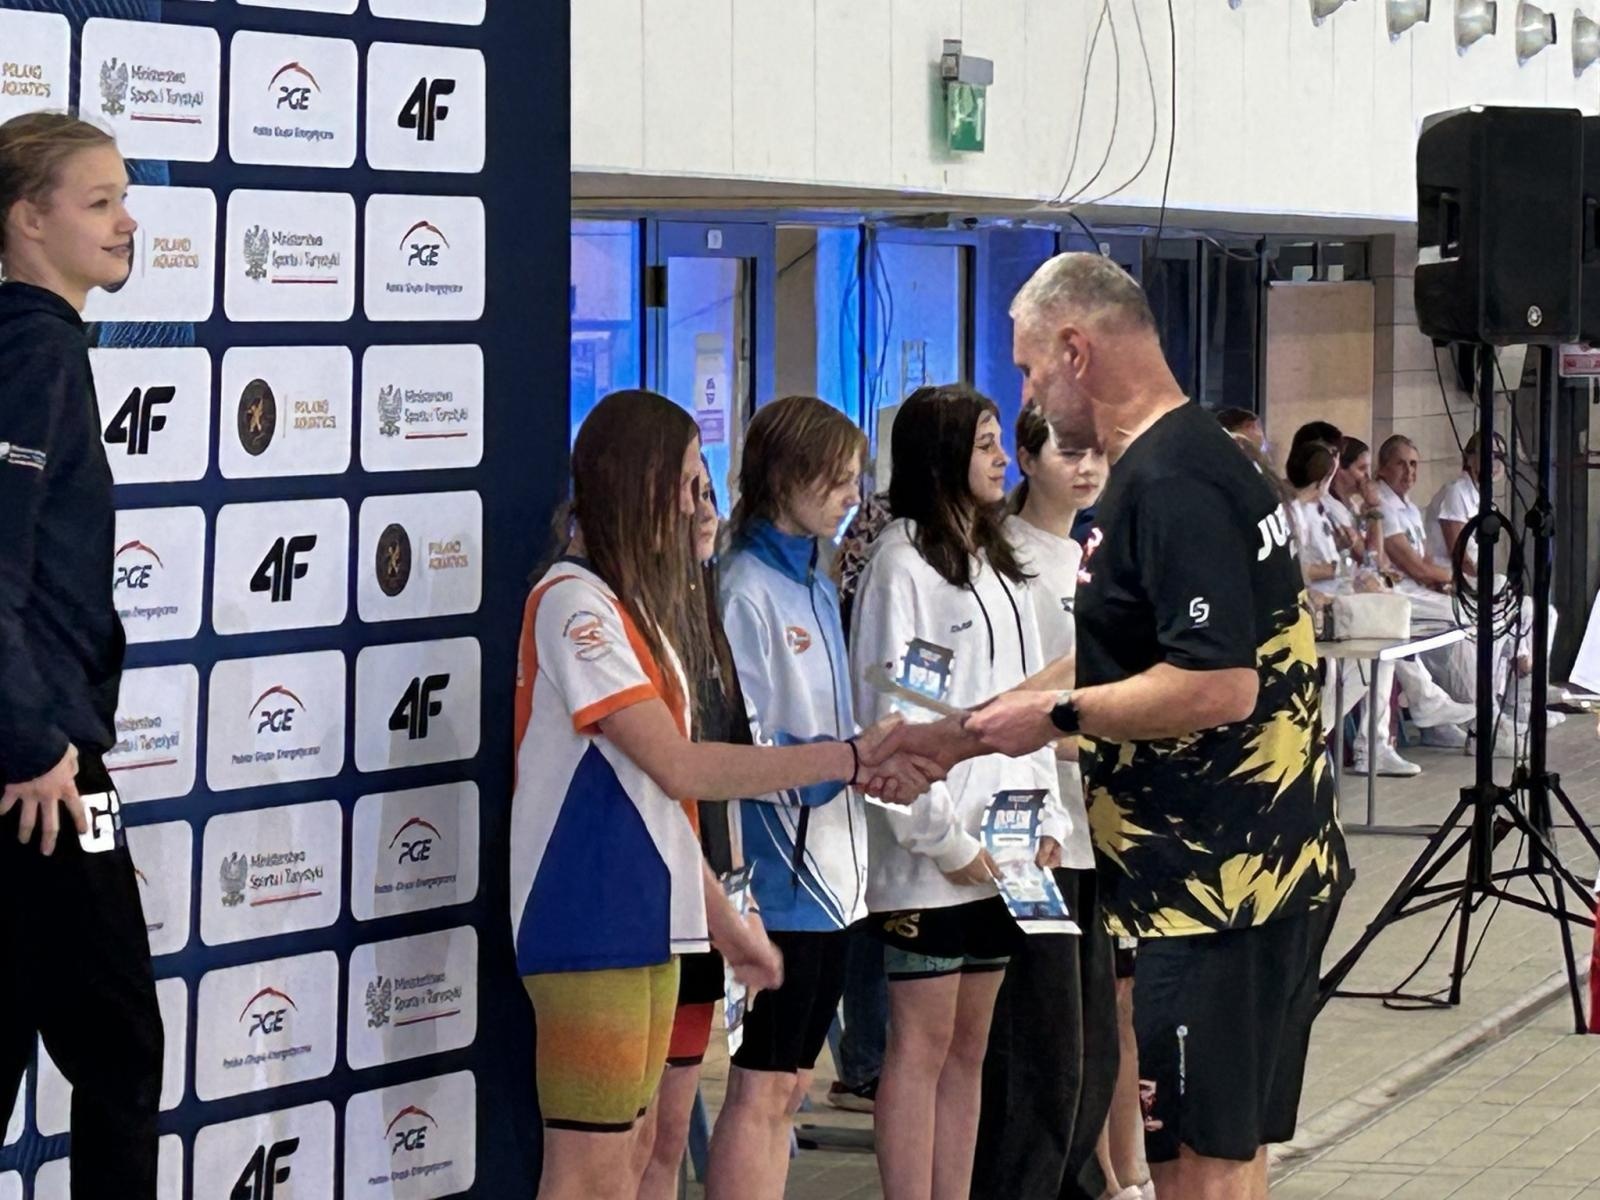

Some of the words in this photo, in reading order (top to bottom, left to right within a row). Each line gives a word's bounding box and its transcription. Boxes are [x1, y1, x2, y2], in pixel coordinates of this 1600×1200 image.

[397, 77, 456, 141] 4F
[104, 386, 176, 455] 4F
[250, 534, 317, 602] 4F
[257, 708, 294, 734] PGE
[388, 673, 450, 740] 4F
